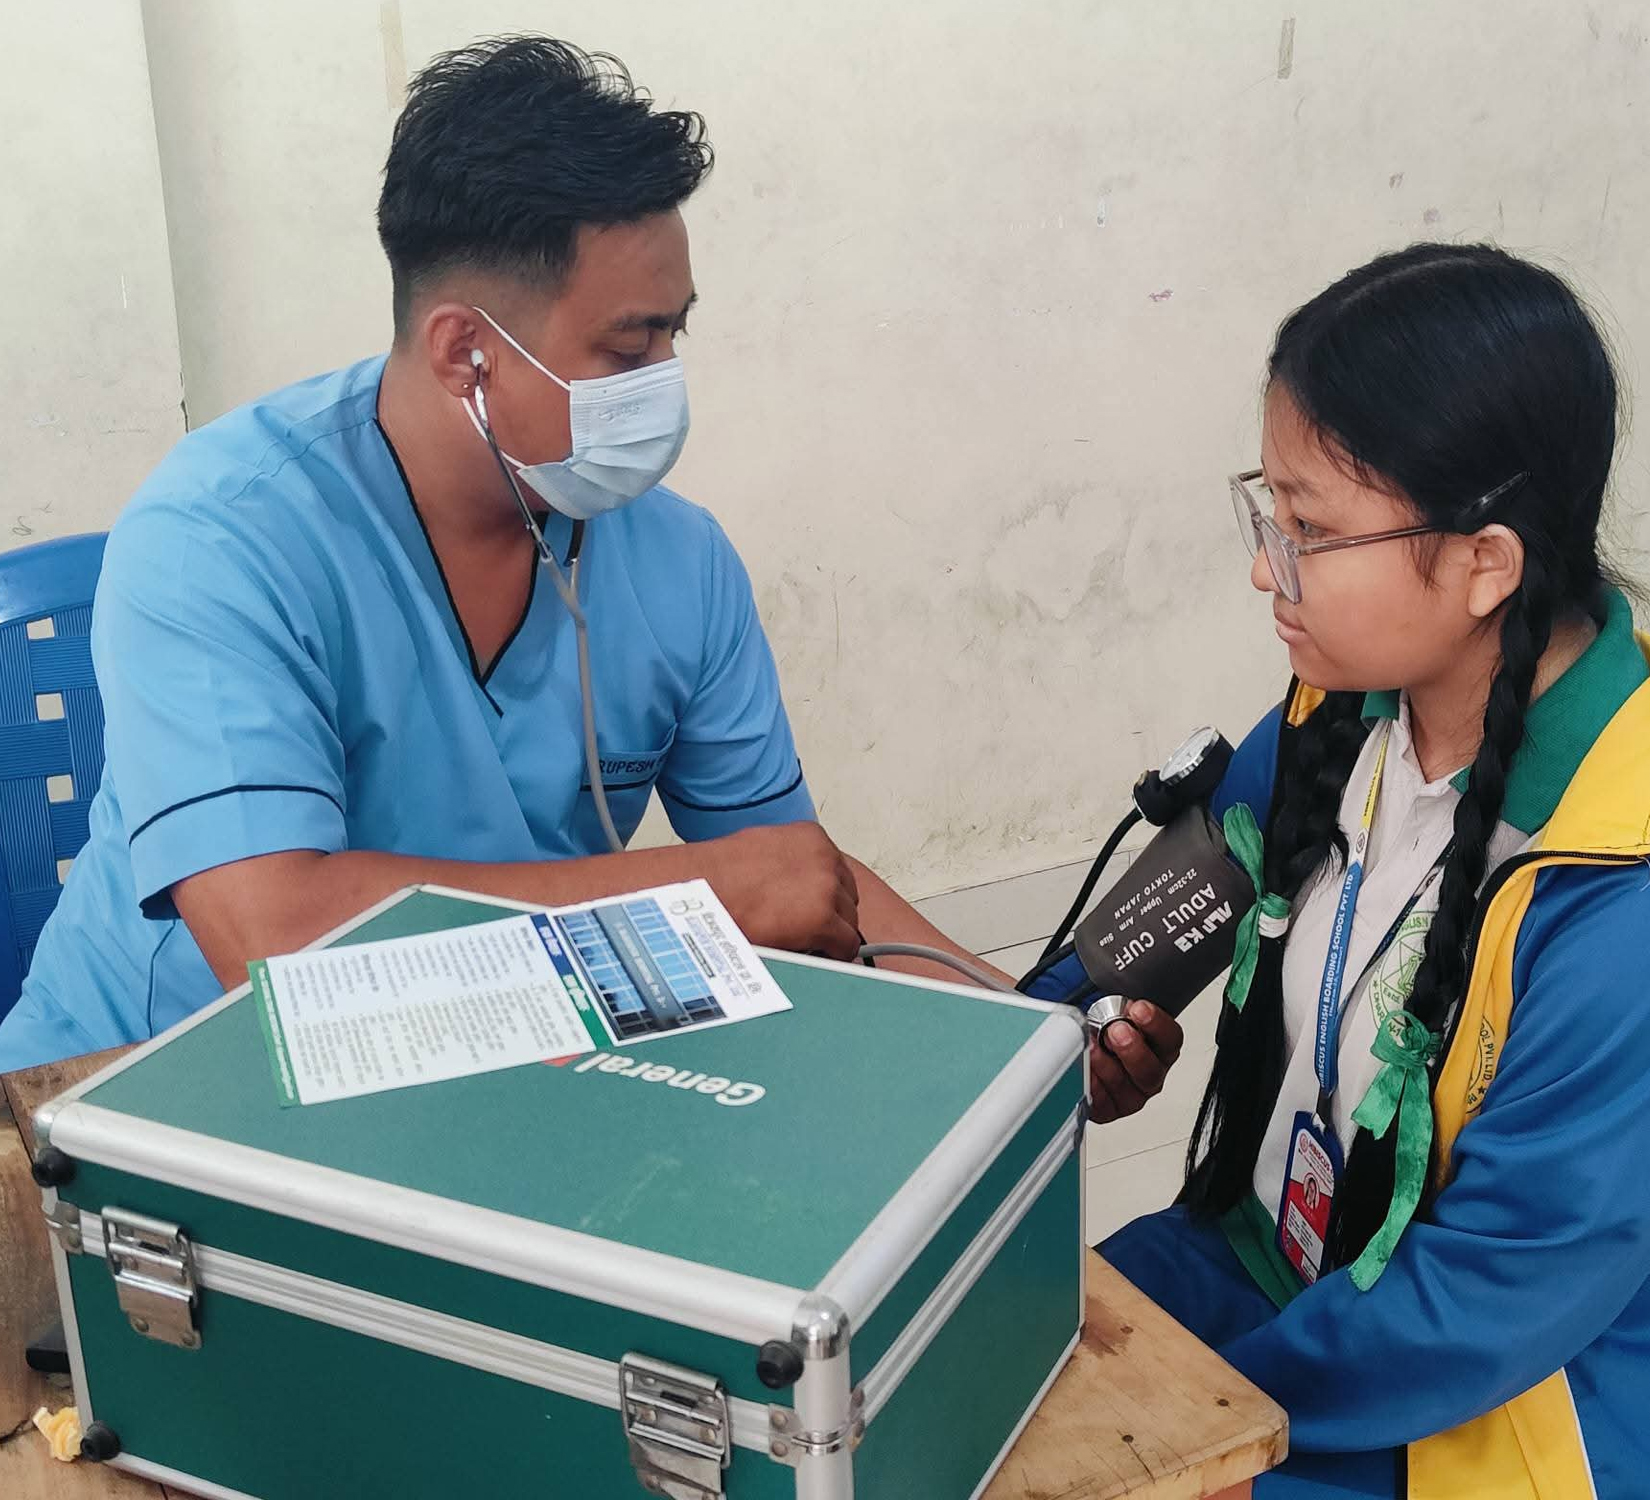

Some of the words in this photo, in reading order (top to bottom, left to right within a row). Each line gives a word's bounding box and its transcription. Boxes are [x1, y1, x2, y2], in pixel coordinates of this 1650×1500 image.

[1144, 868, 1175, 896] TOKYO
[1114, 893, 1141, 919] JAPAN
[1119, 916, 1135, 931] Arm
[1140, 896, 1163, 916] Upper
[1162, 883, 1216, 934] ADULT
[1099, 932, 1115, 947] Size
[1114, 931, 1155, 971] CUFF
[1332, 913, 1345, 951] SCHOOL
[1323, 952, 1338, 1005] BOARDING
[1319, 1005, 1329, 1044] ENGLISH
[574, 1053, 766, 1107] General
